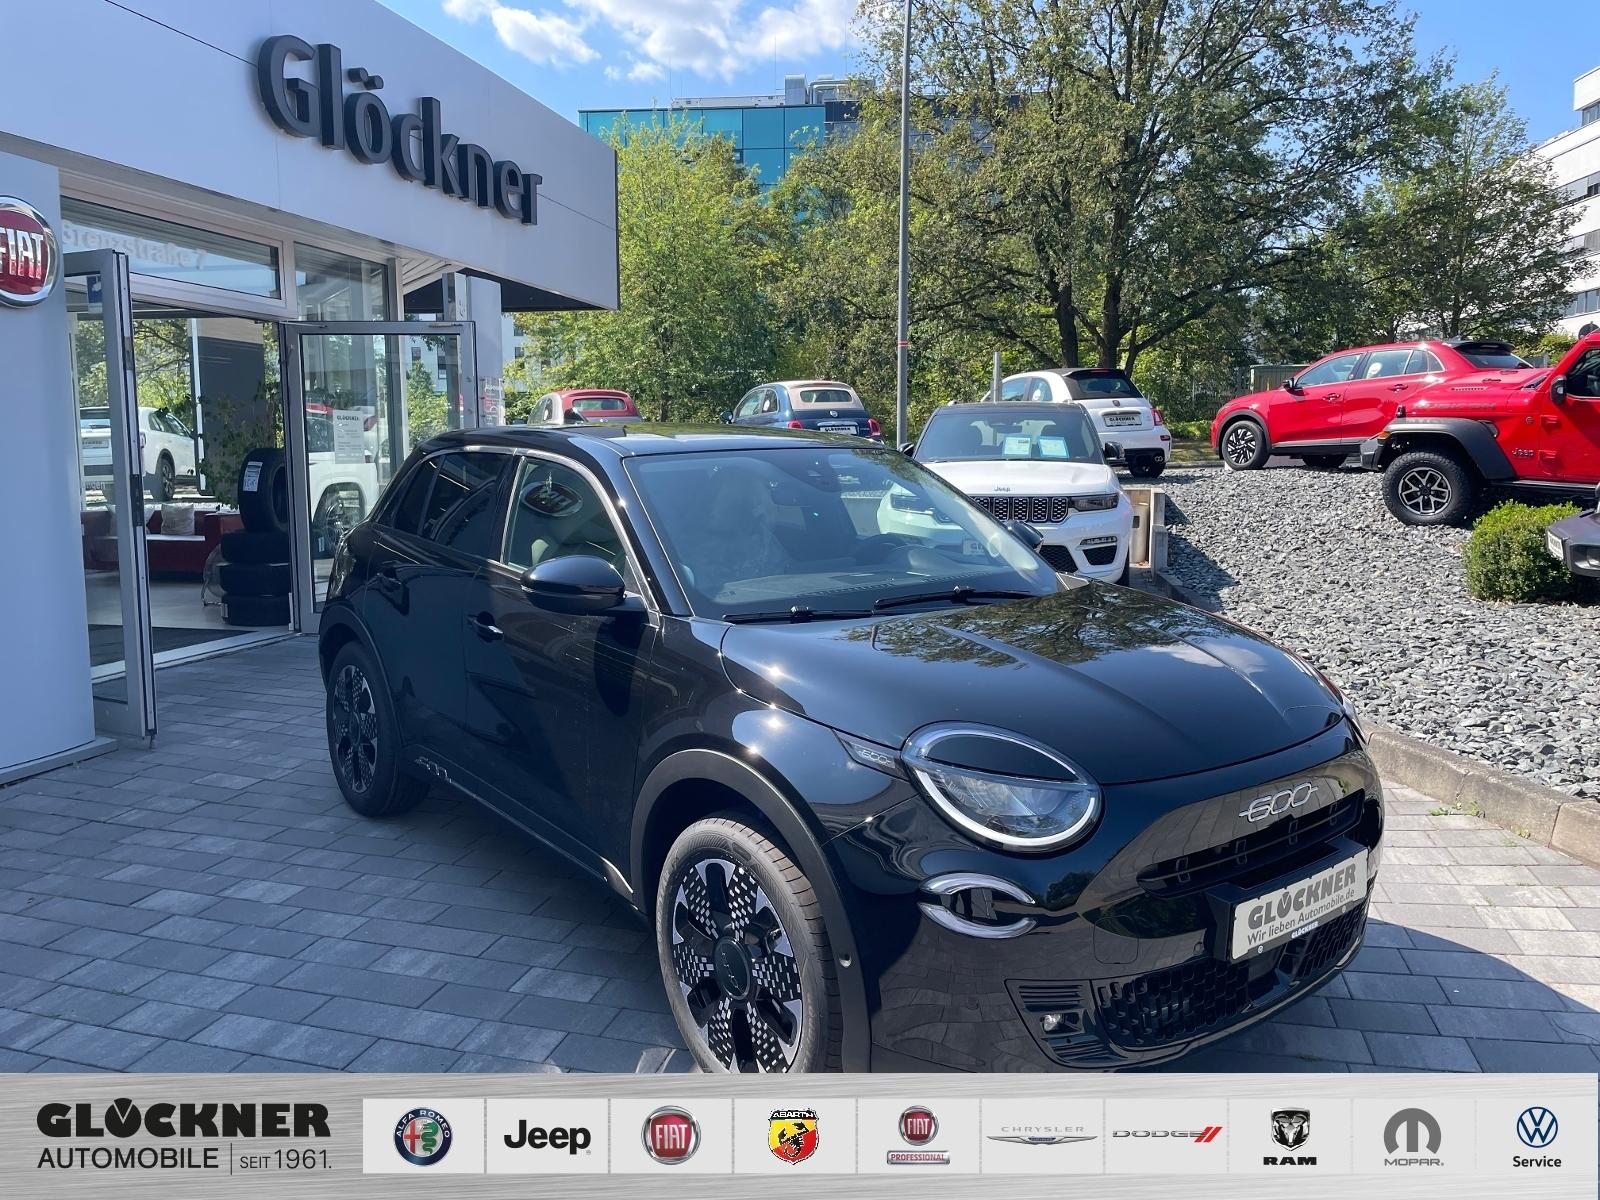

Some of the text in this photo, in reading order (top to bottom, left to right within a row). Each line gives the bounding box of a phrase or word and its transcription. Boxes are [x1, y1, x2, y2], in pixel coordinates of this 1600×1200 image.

[257, 34, 542, 225] Glöckner
[1247, 888, 1355, 946] Wir lieben Automobile.de
